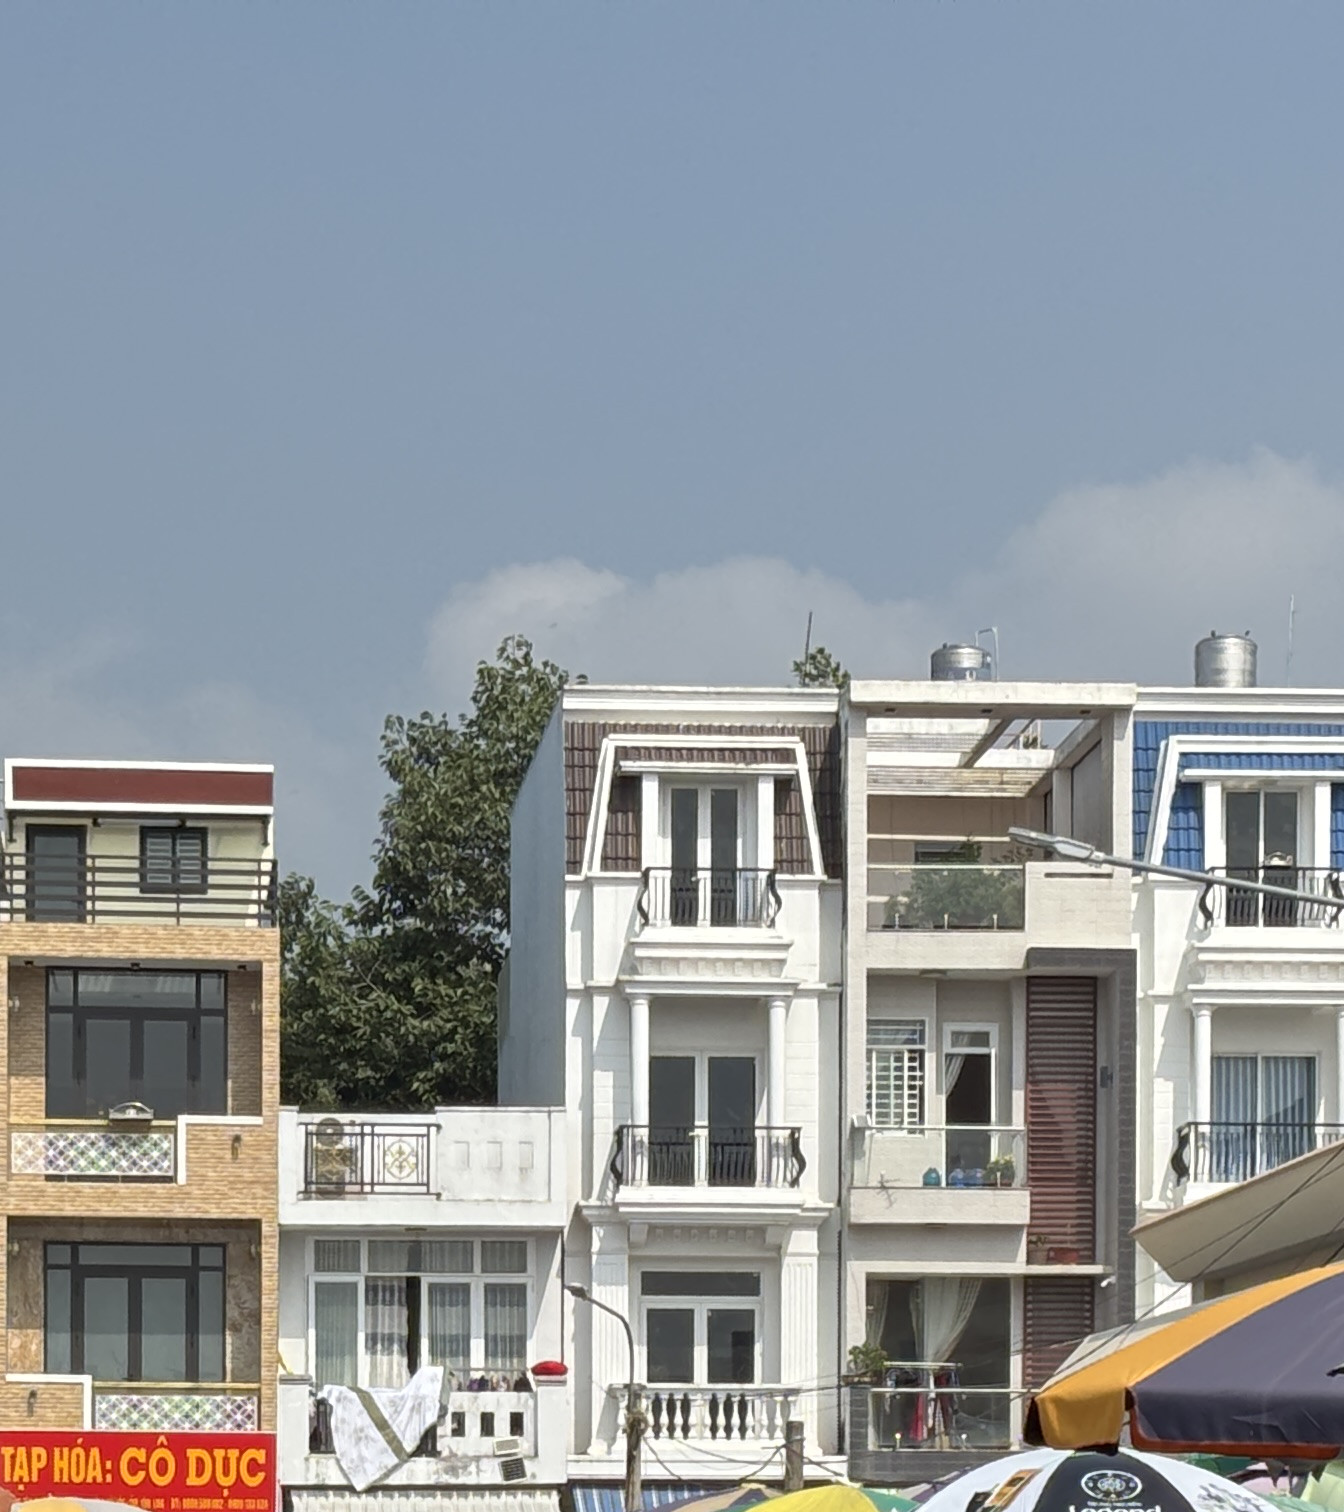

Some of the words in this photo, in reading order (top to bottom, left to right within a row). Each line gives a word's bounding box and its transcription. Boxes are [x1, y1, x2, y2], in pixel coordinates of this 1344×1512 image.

[1, 1446, 48, 1491] TẠP
[53, 1437, 113, 1484] HÓA:
[119, 1435, 177, 1487] CÔ
[186, 1447, 267, 1497] DỤC
